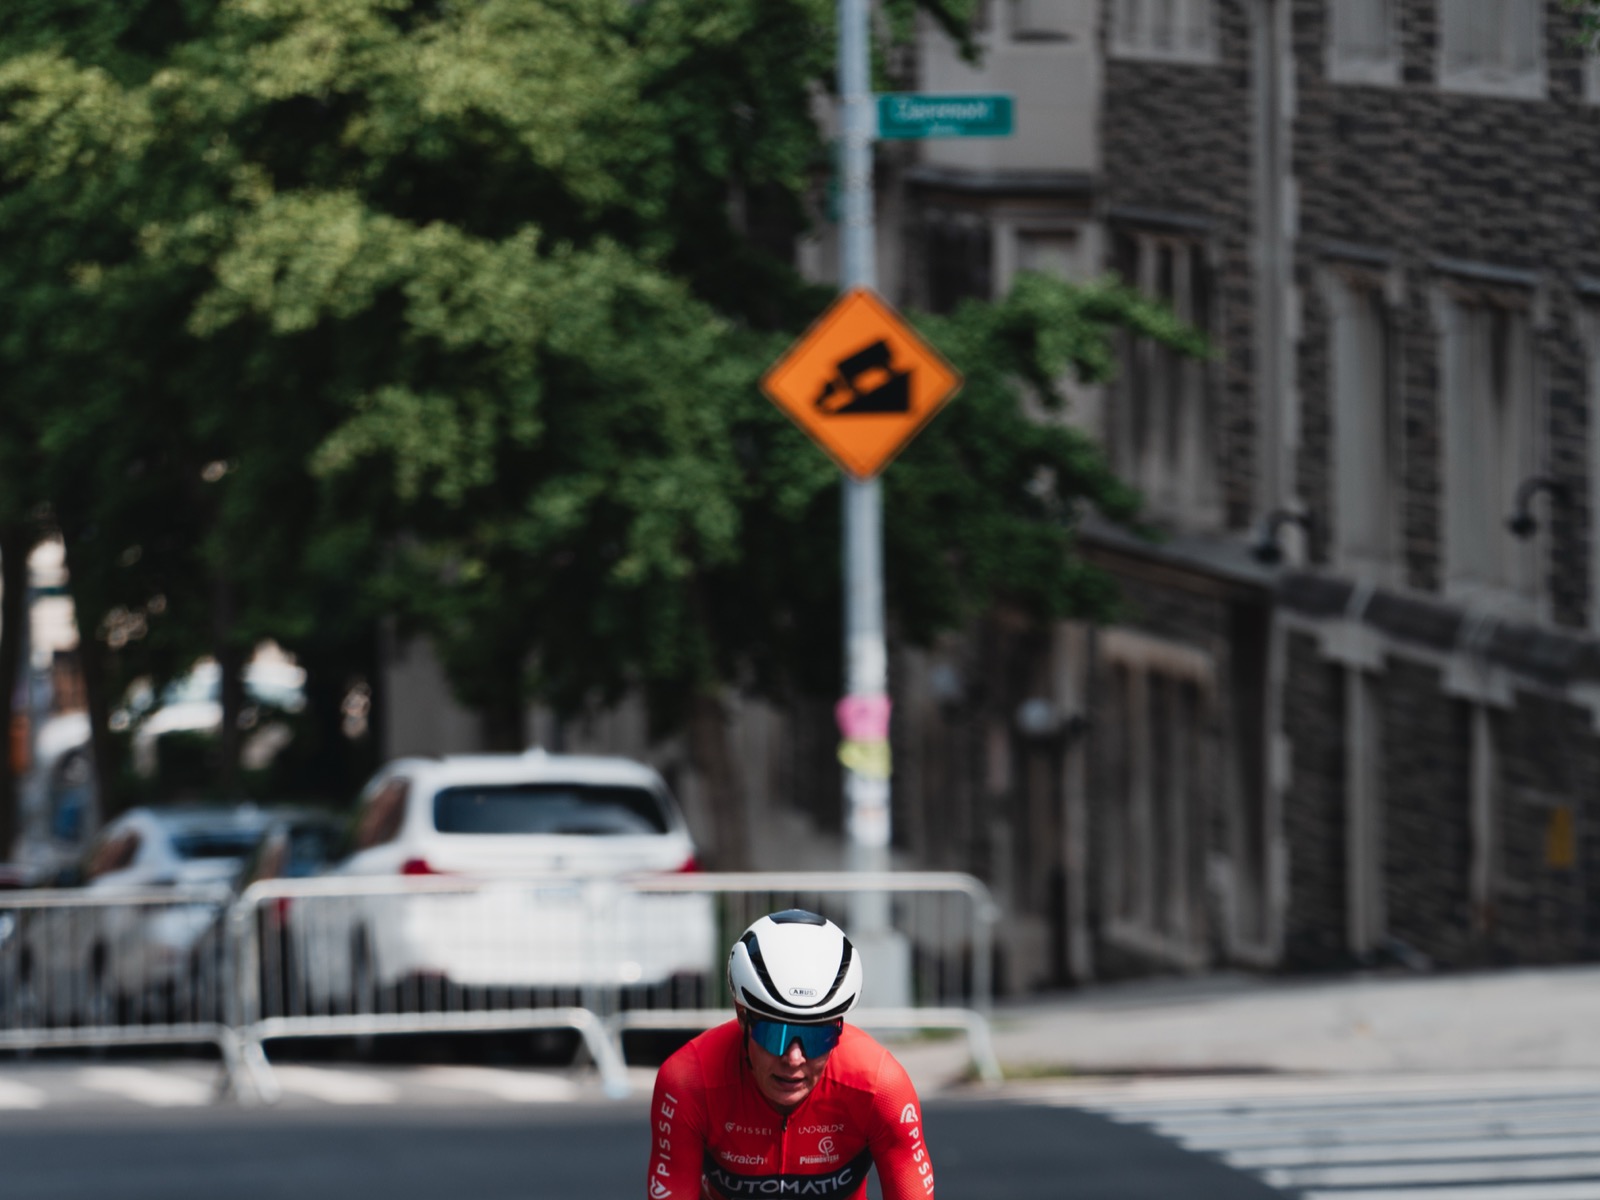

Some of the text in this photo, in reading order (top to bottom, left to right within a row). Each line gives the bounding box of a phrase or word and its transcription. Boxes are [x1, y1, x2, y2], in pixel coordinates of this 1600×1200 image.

[657, 1093, 678, 1177] PISSEI
[736, 1125, 772, 1136] PISSEI
[710, 1168, 853, 1195] AUTOMATIC
[908, 1127, 935, 1195] PISSEI
